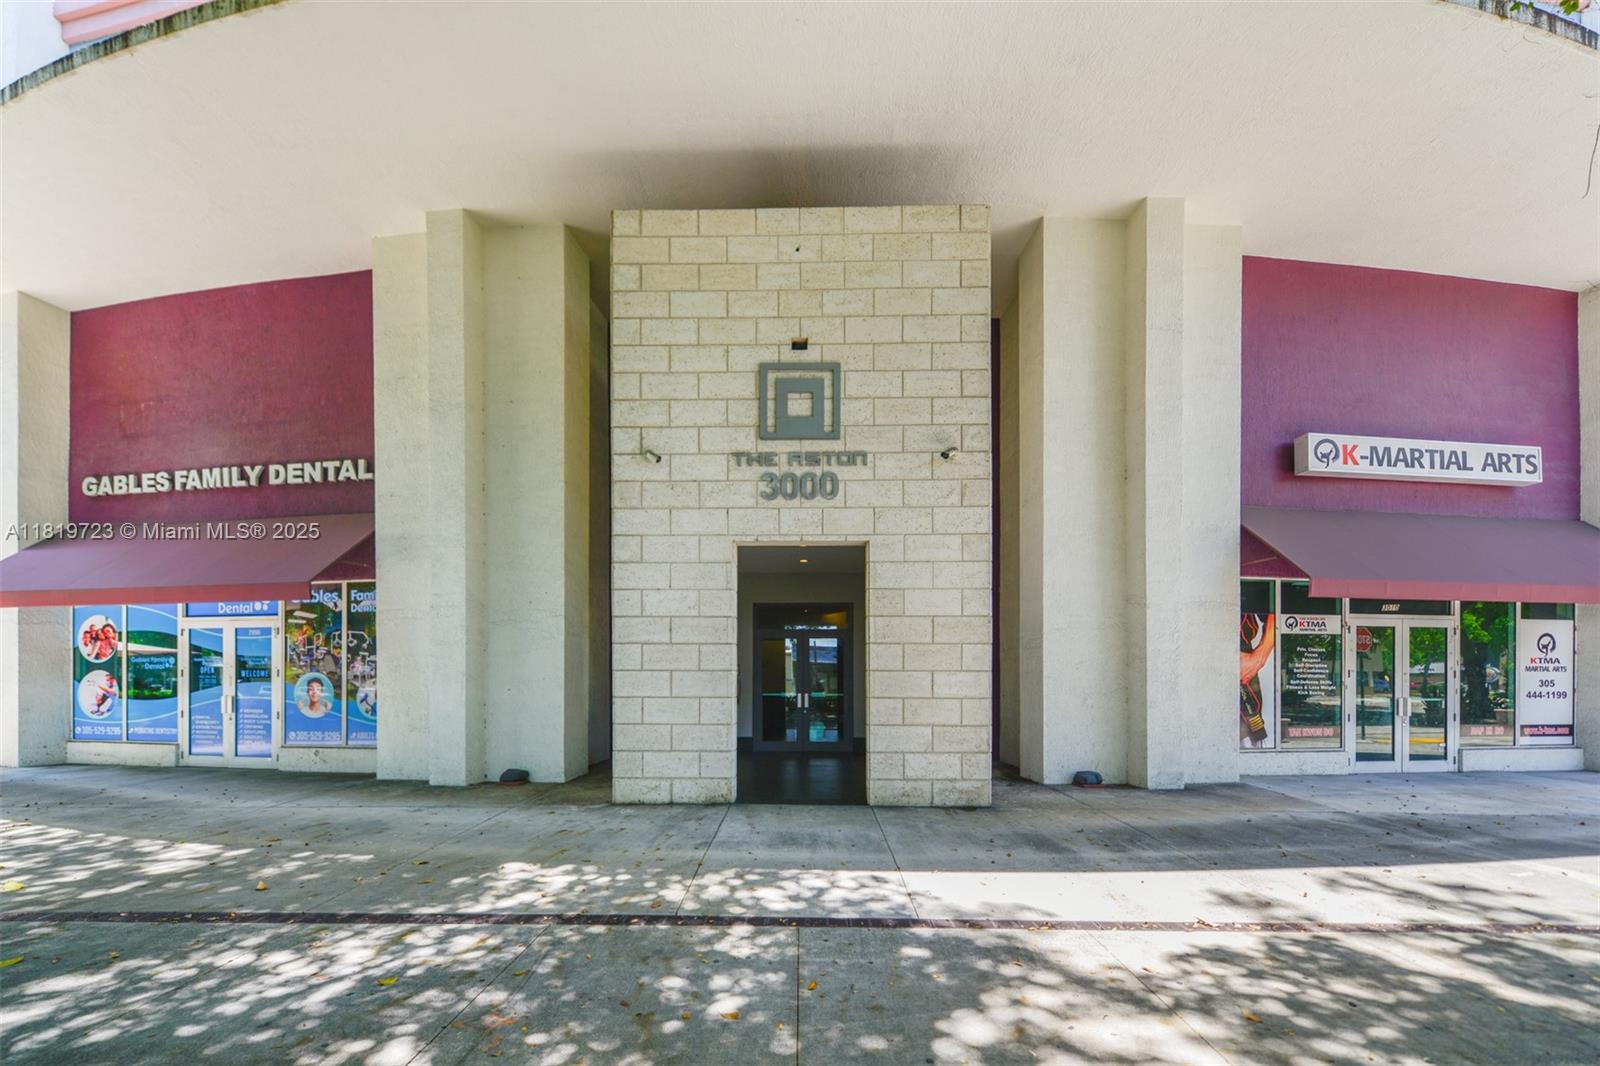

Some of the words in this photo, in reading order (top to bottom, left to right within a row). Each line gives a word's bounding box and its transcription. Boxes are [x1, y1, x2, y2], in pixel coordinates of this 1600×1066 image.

[731, 452, 778, 467] THE
[787, 450, 868, 466] ASTON
[1342, 444, 1474, 471] K-MARTIAL
[1481, 452, 1538, 475] ARTS
[82, 472, 172, 497] GABLES
[174, 465, 264, 490] FAMILY
[269, 459, 374, 484] DENTAL
[760, 471, 839, 500] 3000
[218, 602, 253, 614] Dental
[241, 669, 268, 678] WELCOME
[1526, 691, 1568, 699] 444-1199
